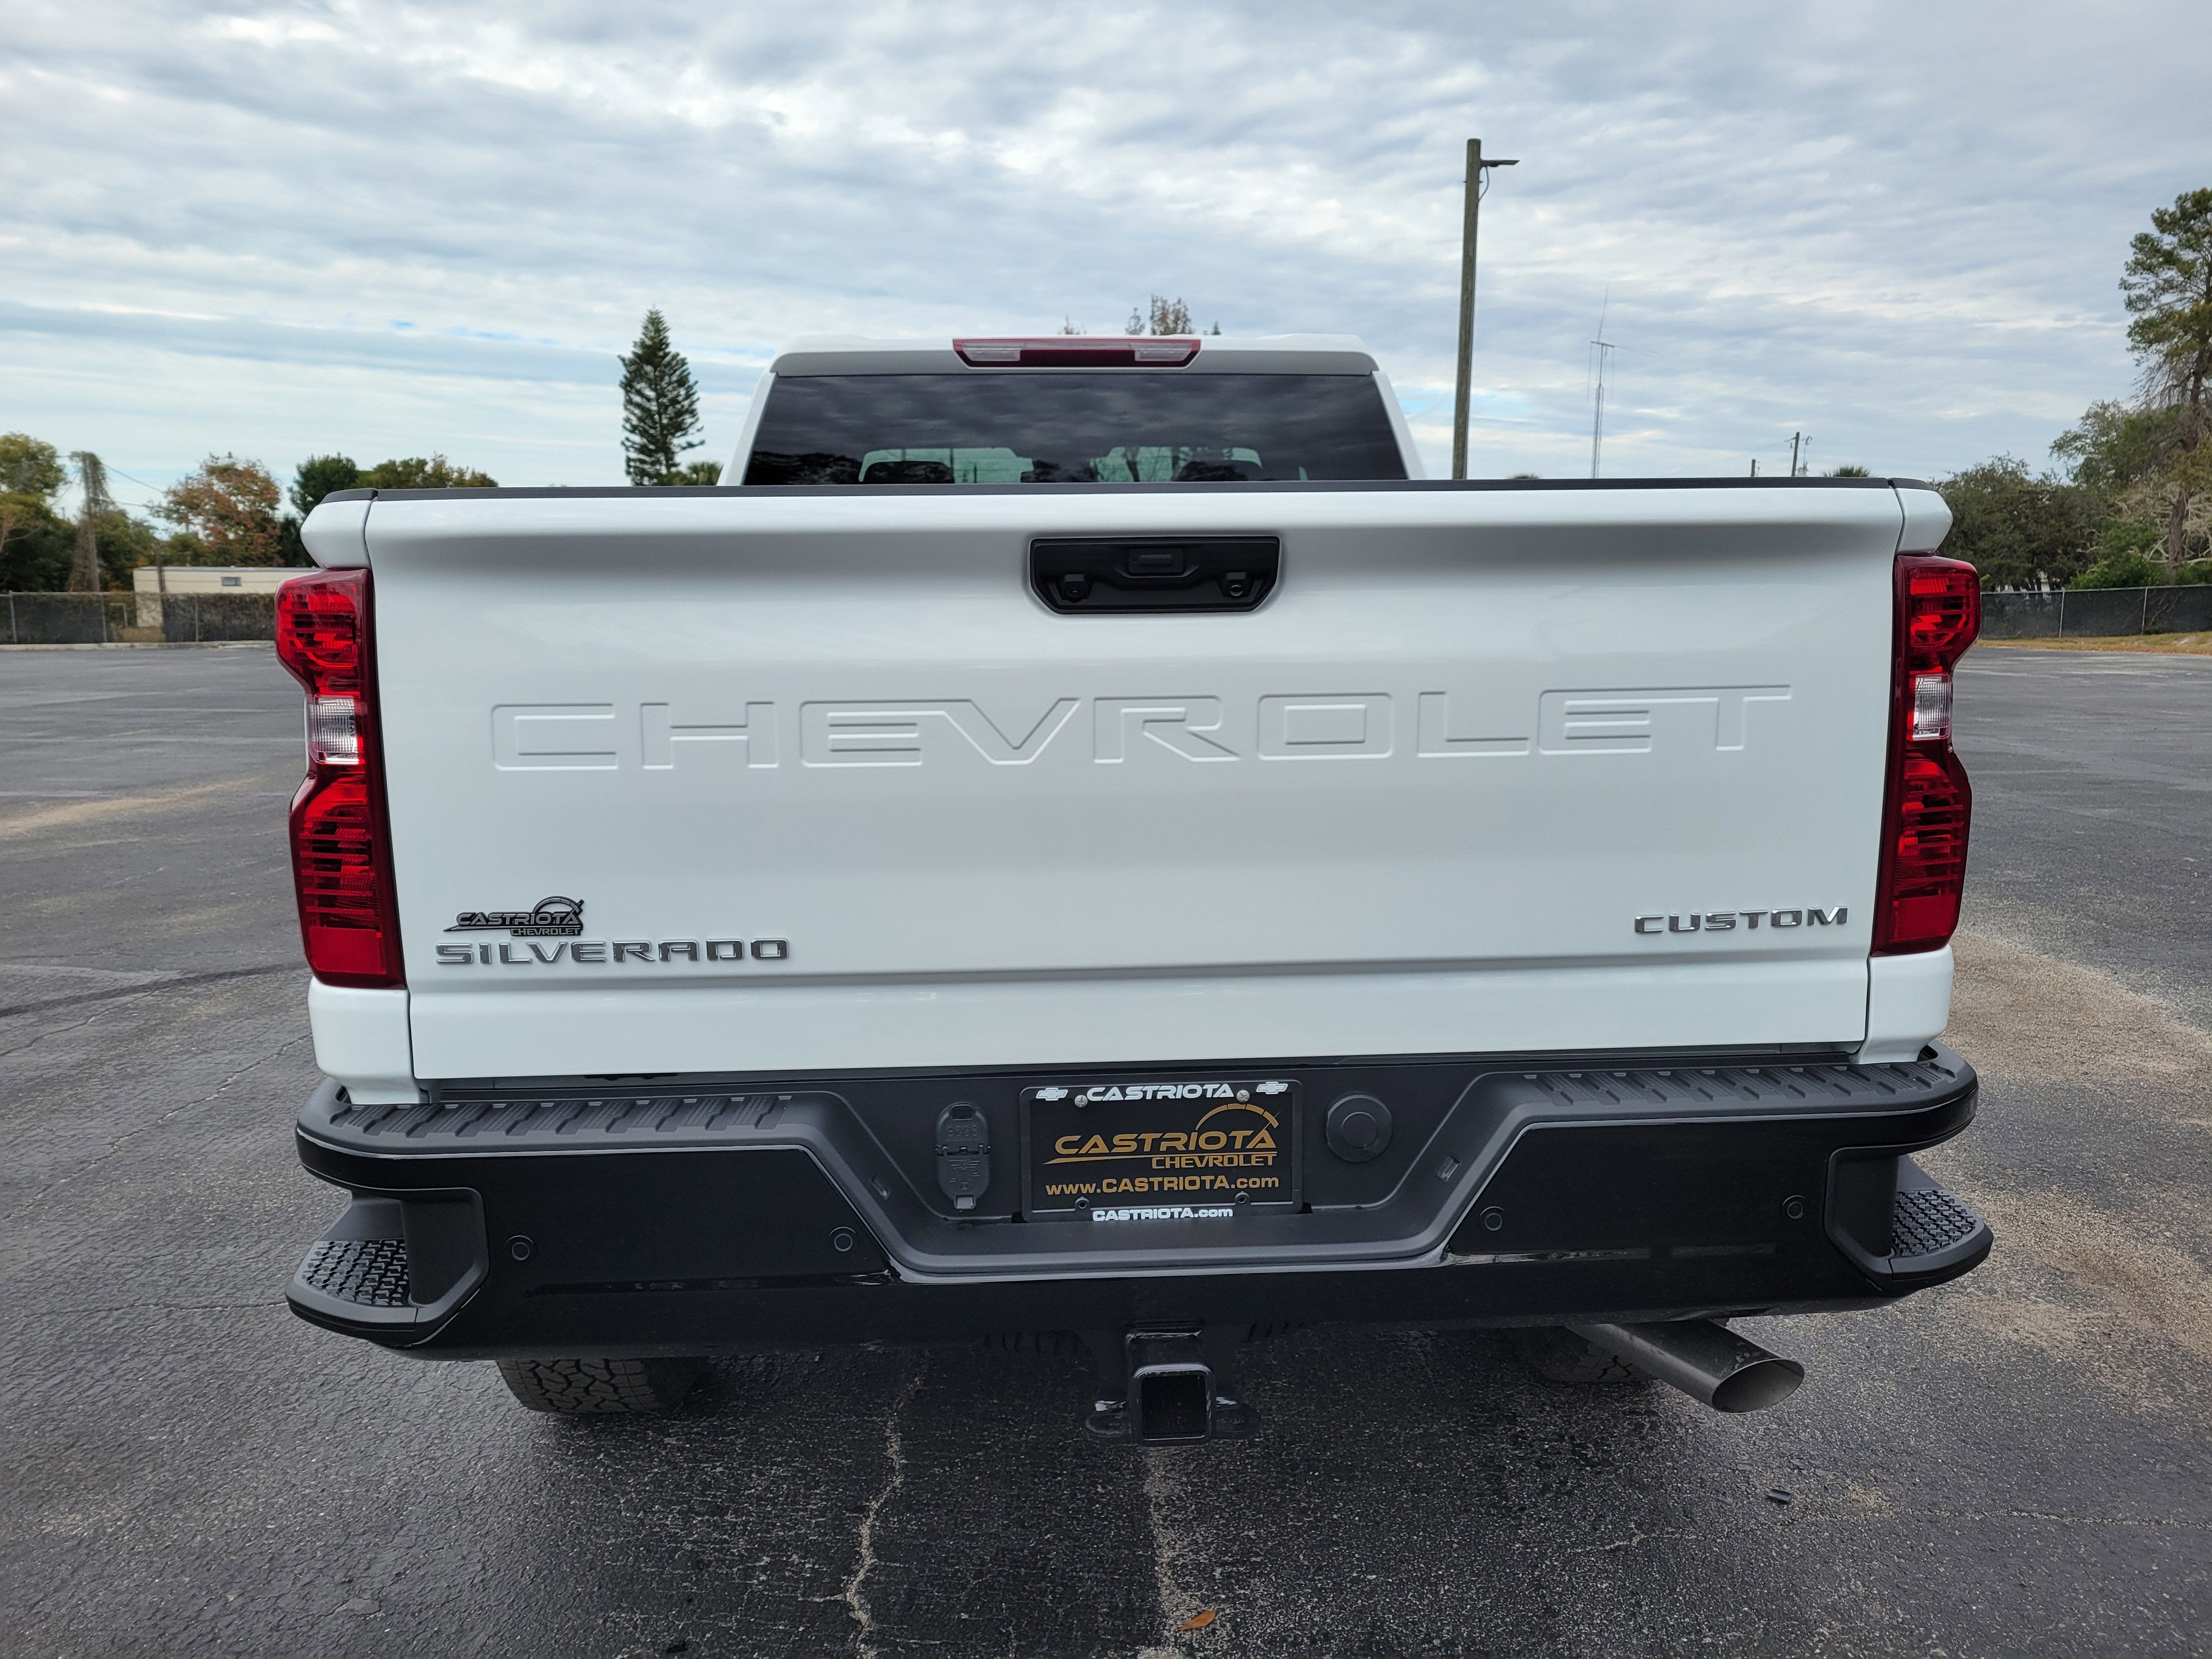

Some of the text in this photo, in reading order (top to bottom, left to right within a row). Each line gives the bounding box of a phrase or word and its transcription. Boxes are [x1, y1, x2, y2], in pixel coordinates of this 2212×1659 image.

[491, 685, 1792, 772] CHEVROLET
[458, 912, 580, 926] CASTRIOTA
[1635, 906, 1848, 933] CUSTOM
[510, 928, 580, 936] CHEVROLET
[436, 939, 789, 964] SILVERADO
[1086, 1083, 1234, 1101] CASTRIOTA
[1054, 1130, 1277, 1154] CASTRIOTA
[1152, 1154, 1277, 1169] CHEVROLET
[1045, 1175, 1279, 1195] www.CASTRIOTA.com
[1092, 1207, 1233, 1222] CASTRIOTA.com
